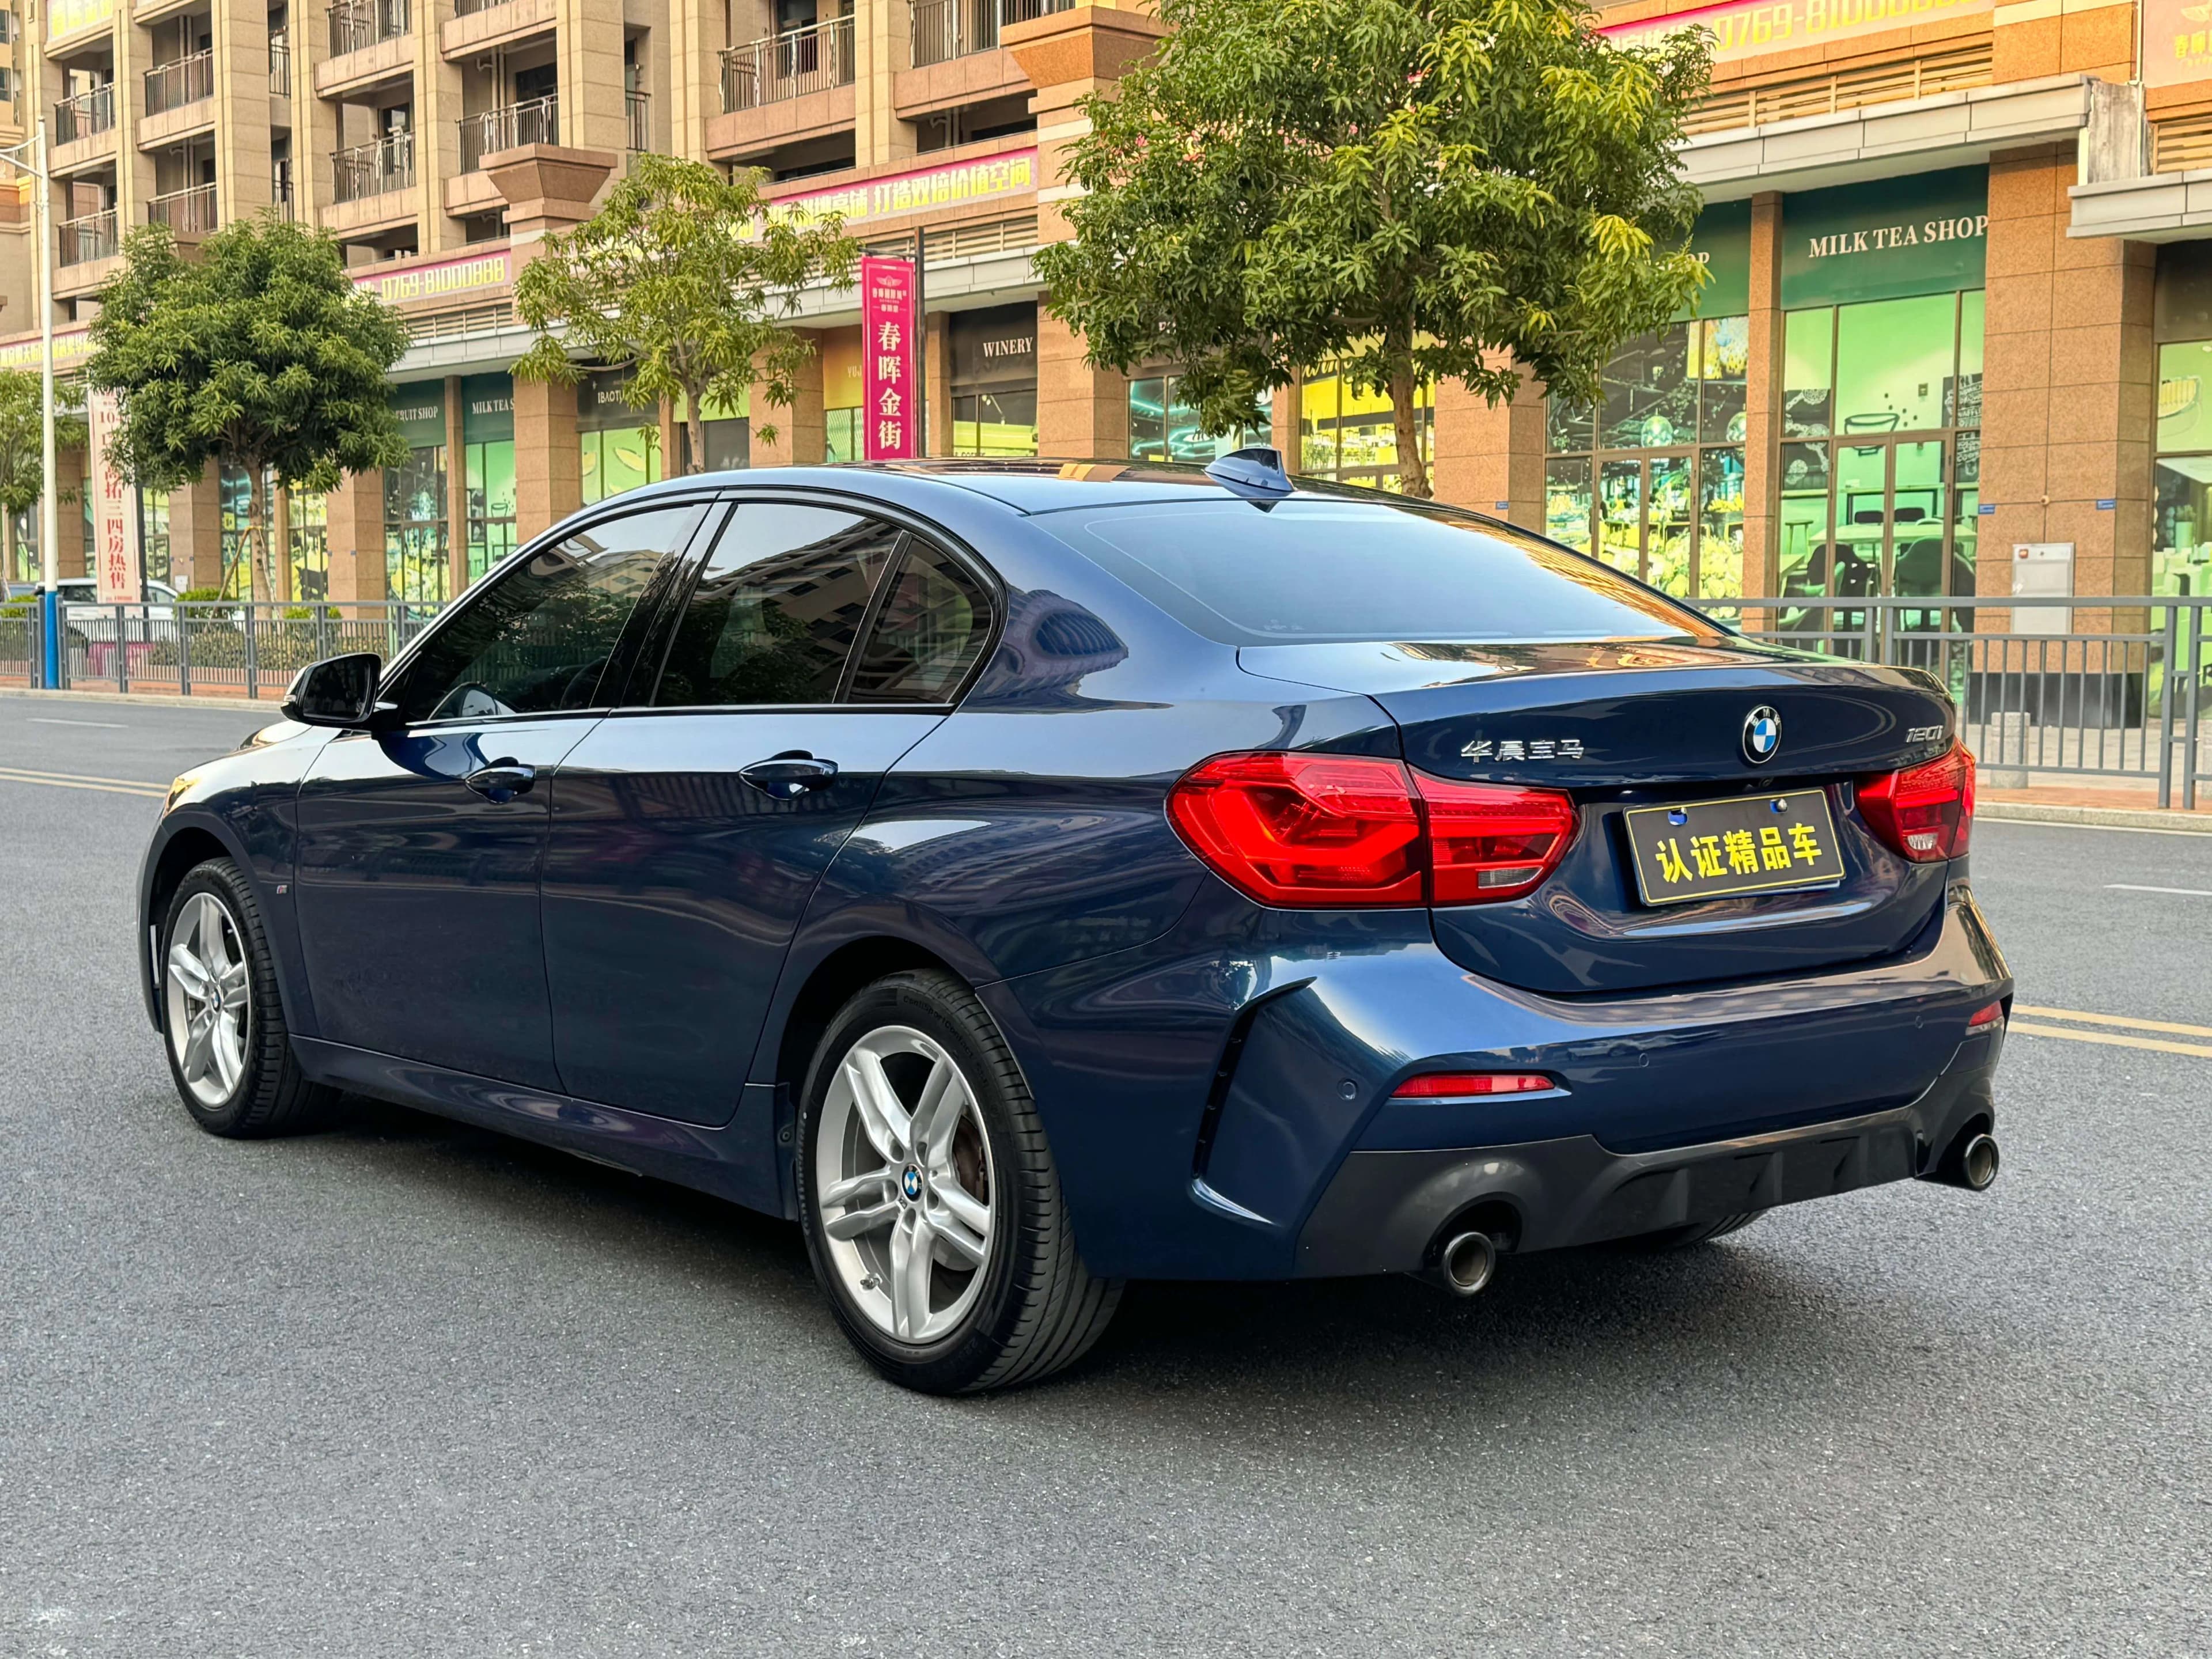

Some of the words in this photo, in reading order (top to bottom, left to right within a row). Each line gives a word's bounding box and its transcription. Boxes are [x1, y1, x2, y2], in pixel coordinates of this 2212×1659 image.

[1713, 0, 1982, 51] 0769-8100
[874, 156, 1031, 214] 打造双倍价值空间
[1808, 230, 1869, 258] MILK
[1873, 225, 1919, 249] TEA
[1923, 214, 1988, 243] SHOP
[381, 257, 505, 301] 0769-81000888
[983, 337, 1033, 357] WINERY
[472, 401, 492, 414] MILK
[494, 398, 510, 411] TEA
[877, 321, 902, 450] 春晖金街
[418, 406, 438, 419] SHOP
[1460, 739, 1585, 764] 华晨宝马
[1906, 725, 1944, 743] 120i
[1655, 822, 1823, 884] 认证精品车
